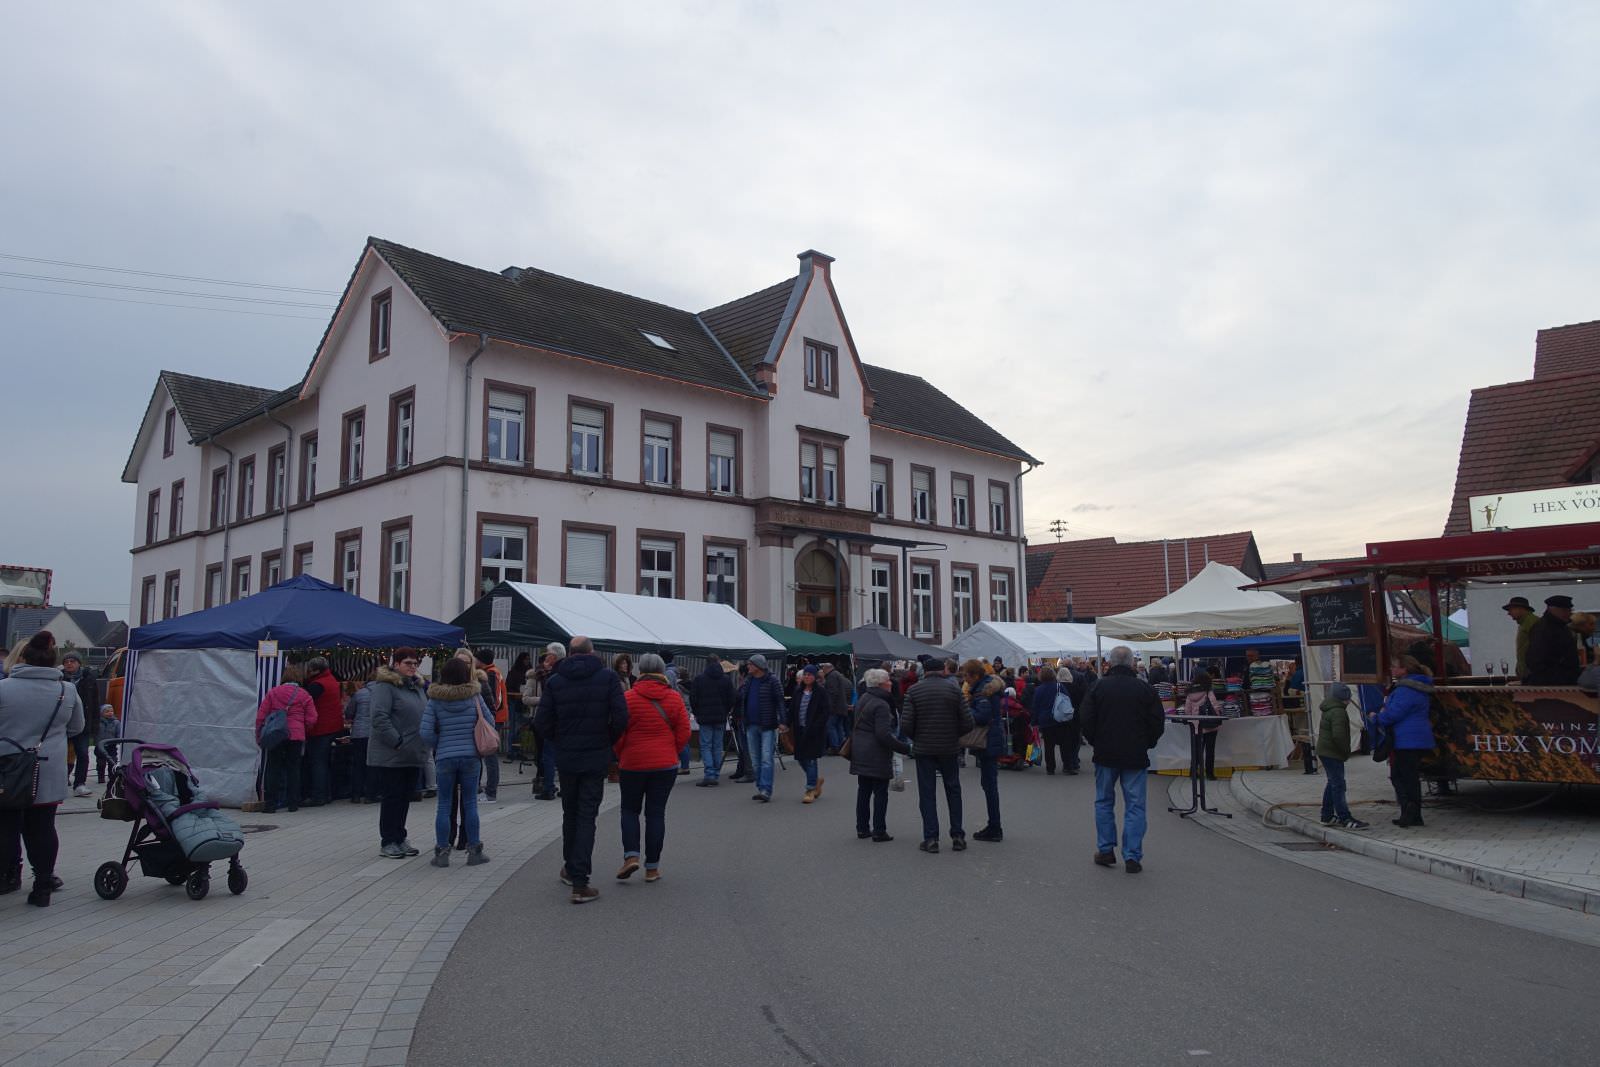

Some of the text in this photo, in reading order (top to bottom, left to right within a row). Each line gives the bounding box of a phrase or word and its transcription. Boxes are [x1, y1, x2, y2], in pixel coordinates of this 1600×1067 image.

[1533, 498, 1600, 514] HEX VO
[1466, 562, 1492, 573] HEX
[1496, 560, 1528, 569] VOM
[1541, 722, 1596, 731] WINZ
[1472, 734, 1531, 753] HEX
